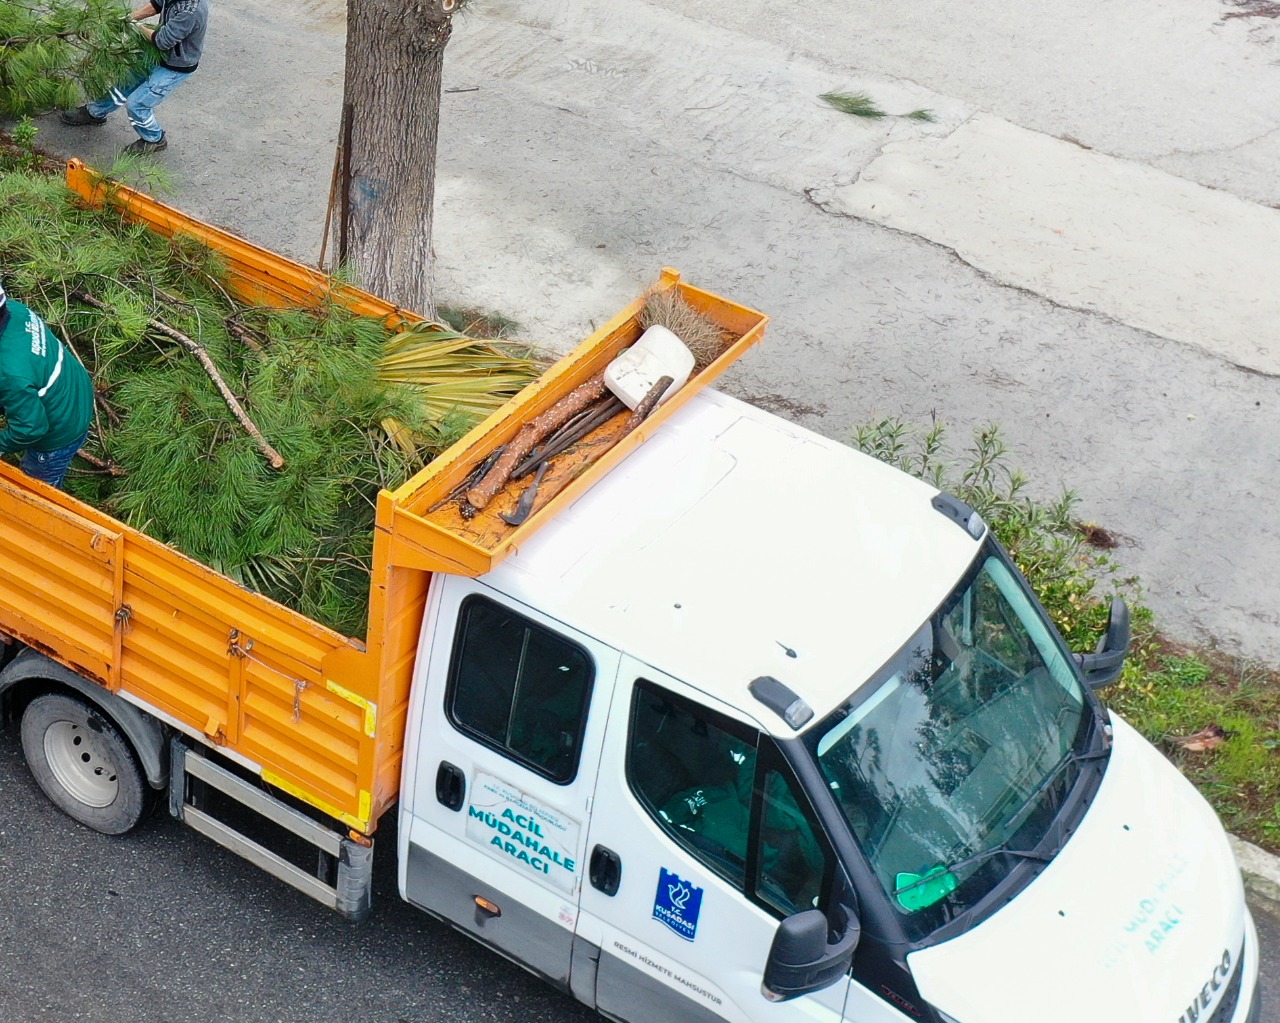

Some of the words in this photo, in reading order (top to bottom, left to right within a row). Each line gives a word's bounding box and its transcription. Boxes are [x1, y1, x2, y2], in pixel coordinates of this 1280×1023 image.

[468, 805, 575, 872] MÜDAHALE
[501, 808, 545, 839] ACİL
[490, 835, 549, 874] ARACI
[1145, 903, 1184, 954] ARACI
[614, 941, 638, 958] RESMİ
[638, 955, 673, 977] HİZMETE
[673, 974, 722, 1005] MAHSUSTUR
